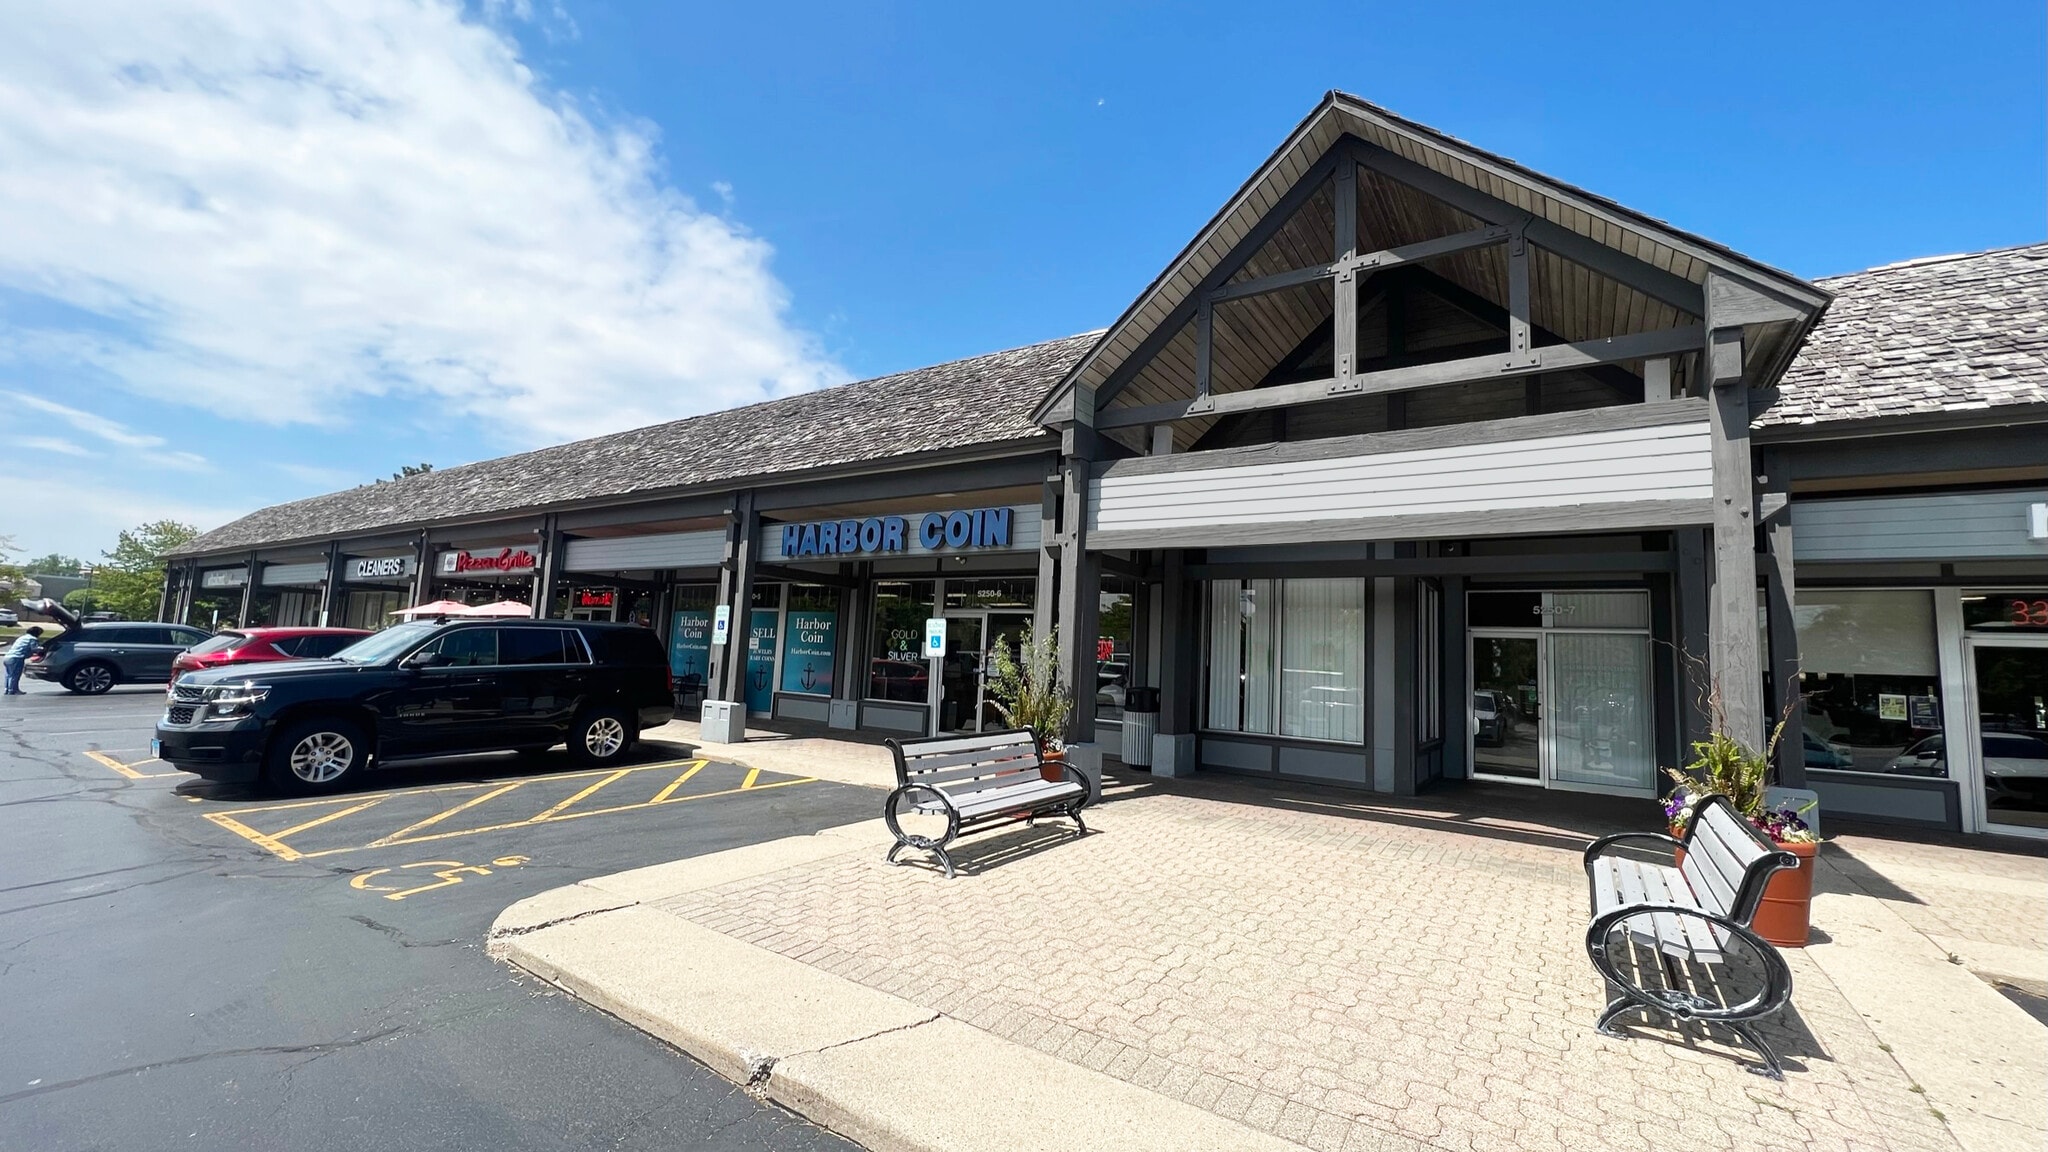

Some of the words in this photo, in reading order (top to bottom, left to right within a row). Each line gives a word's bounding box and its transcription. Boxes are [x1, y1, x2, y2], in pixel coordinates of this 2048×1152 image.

[782, 516, 909, 556] HARBOR
[919, 508, 1014, 550] COIN
[457, 550, 496, 572] Pizza
[498, 547, 536, 571] Grille
[357, 558, 405, 577] CLEANERS
[1532, 605, 1576, 615] 5250-7
[680, 616, 708, 628] Harbor
[795, 617, 832, 630] Harbor
[684, 627, 702, 639] Coin
[752, 627, 776, 639] SELL
[800, 630, 824, 643] Coin
[891, 629, 918, 640] GOLD
[899, 640, 908, 651] &
[790, 647, 832, 657] HarborCoin.com
[887, 650, 918, 661] SILVER
